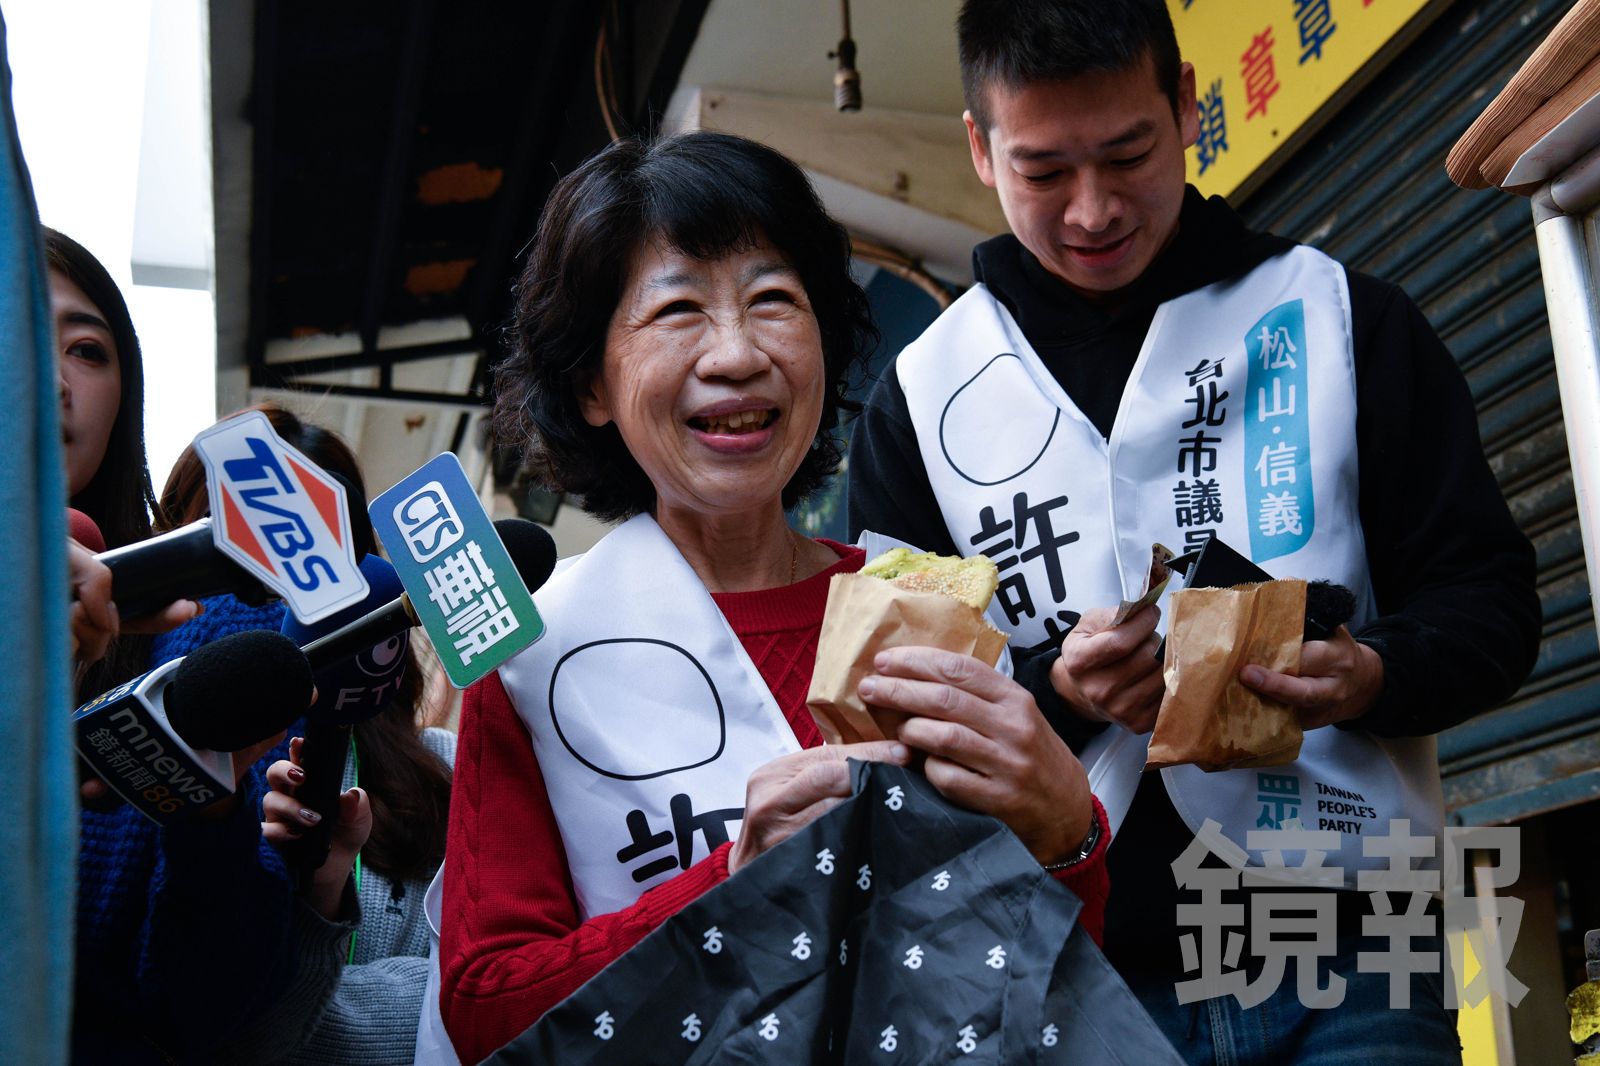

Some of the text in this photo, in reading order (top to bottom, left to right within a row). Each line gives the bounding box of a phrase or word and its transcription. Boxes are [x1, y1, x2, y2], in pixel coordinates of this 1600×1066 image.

[223, 437, 340, 592] TVBS
[423, 540, 520, 667] 華視
[108, 707, 215, 803] mnews
[1315, 782, 1365, 802] TAIWAN
[1317, 800, 1377, 819] PEOPLE'S
[1319, 818, 1362, 835] PARTY
